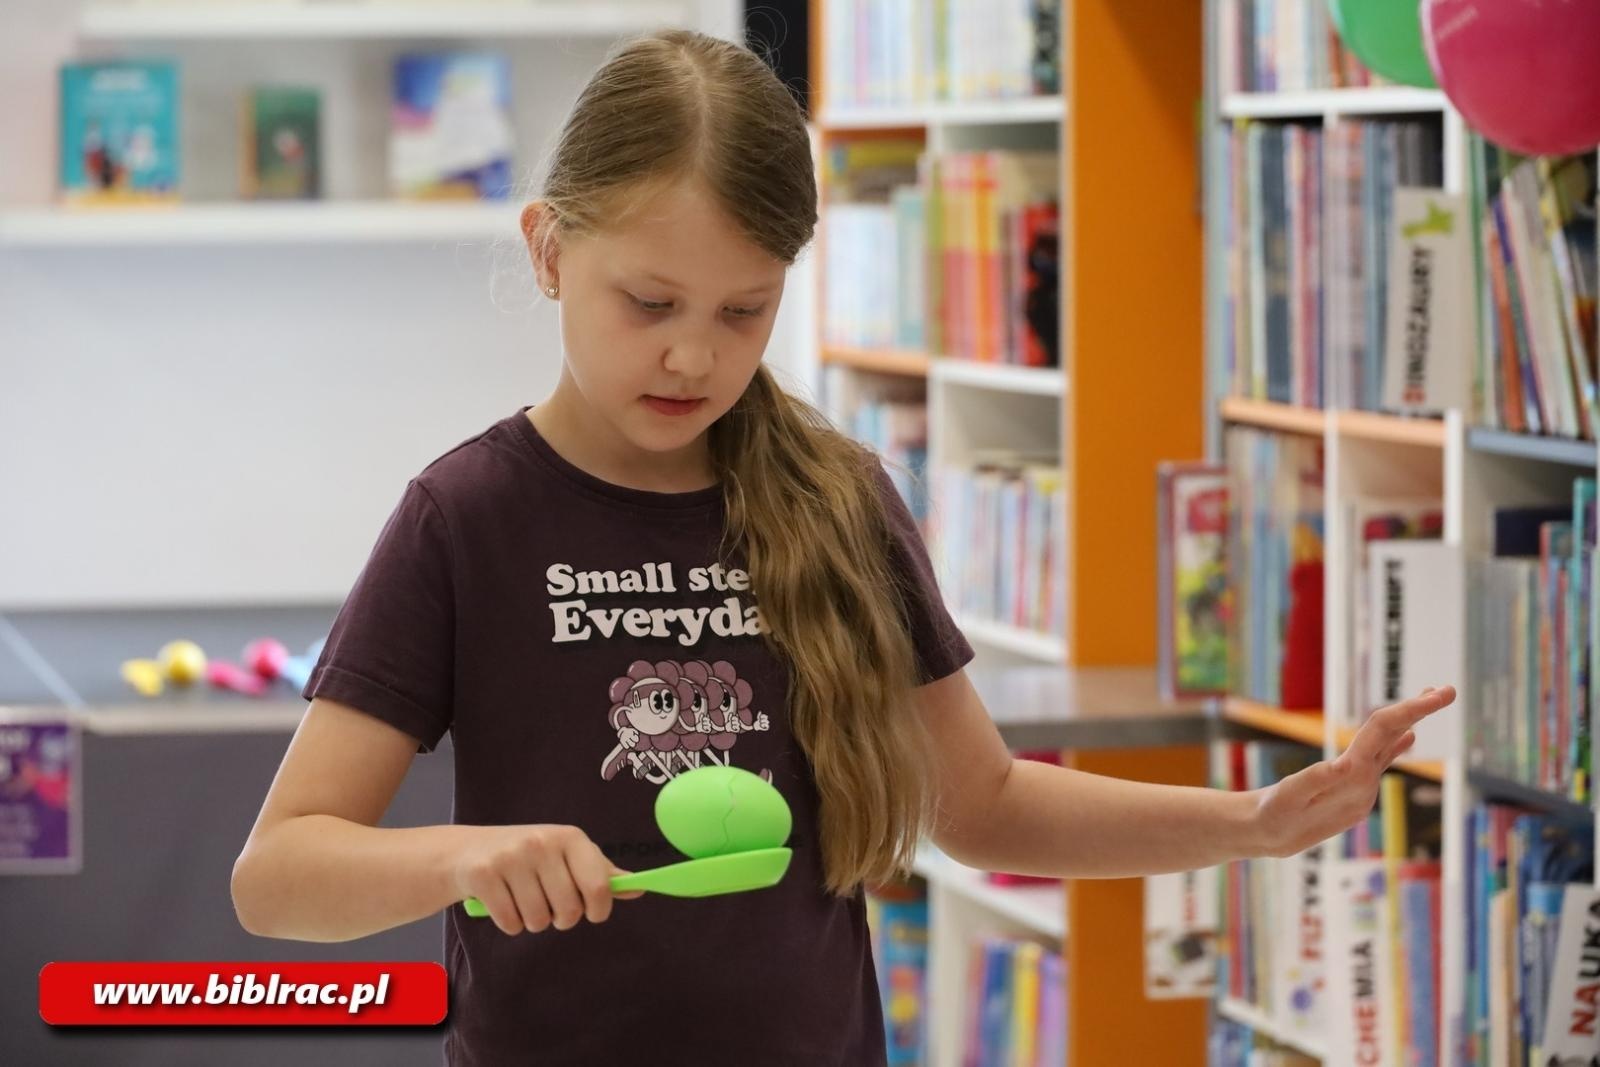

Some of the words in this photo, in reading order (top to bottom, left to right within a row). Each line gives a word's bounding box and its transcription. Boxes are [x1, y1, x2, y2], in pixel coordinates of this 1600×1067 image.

[546, 562, 676, 596] Small
[688, 562, 757, 595] ste
[549, 596, 771, 646] Everyda
